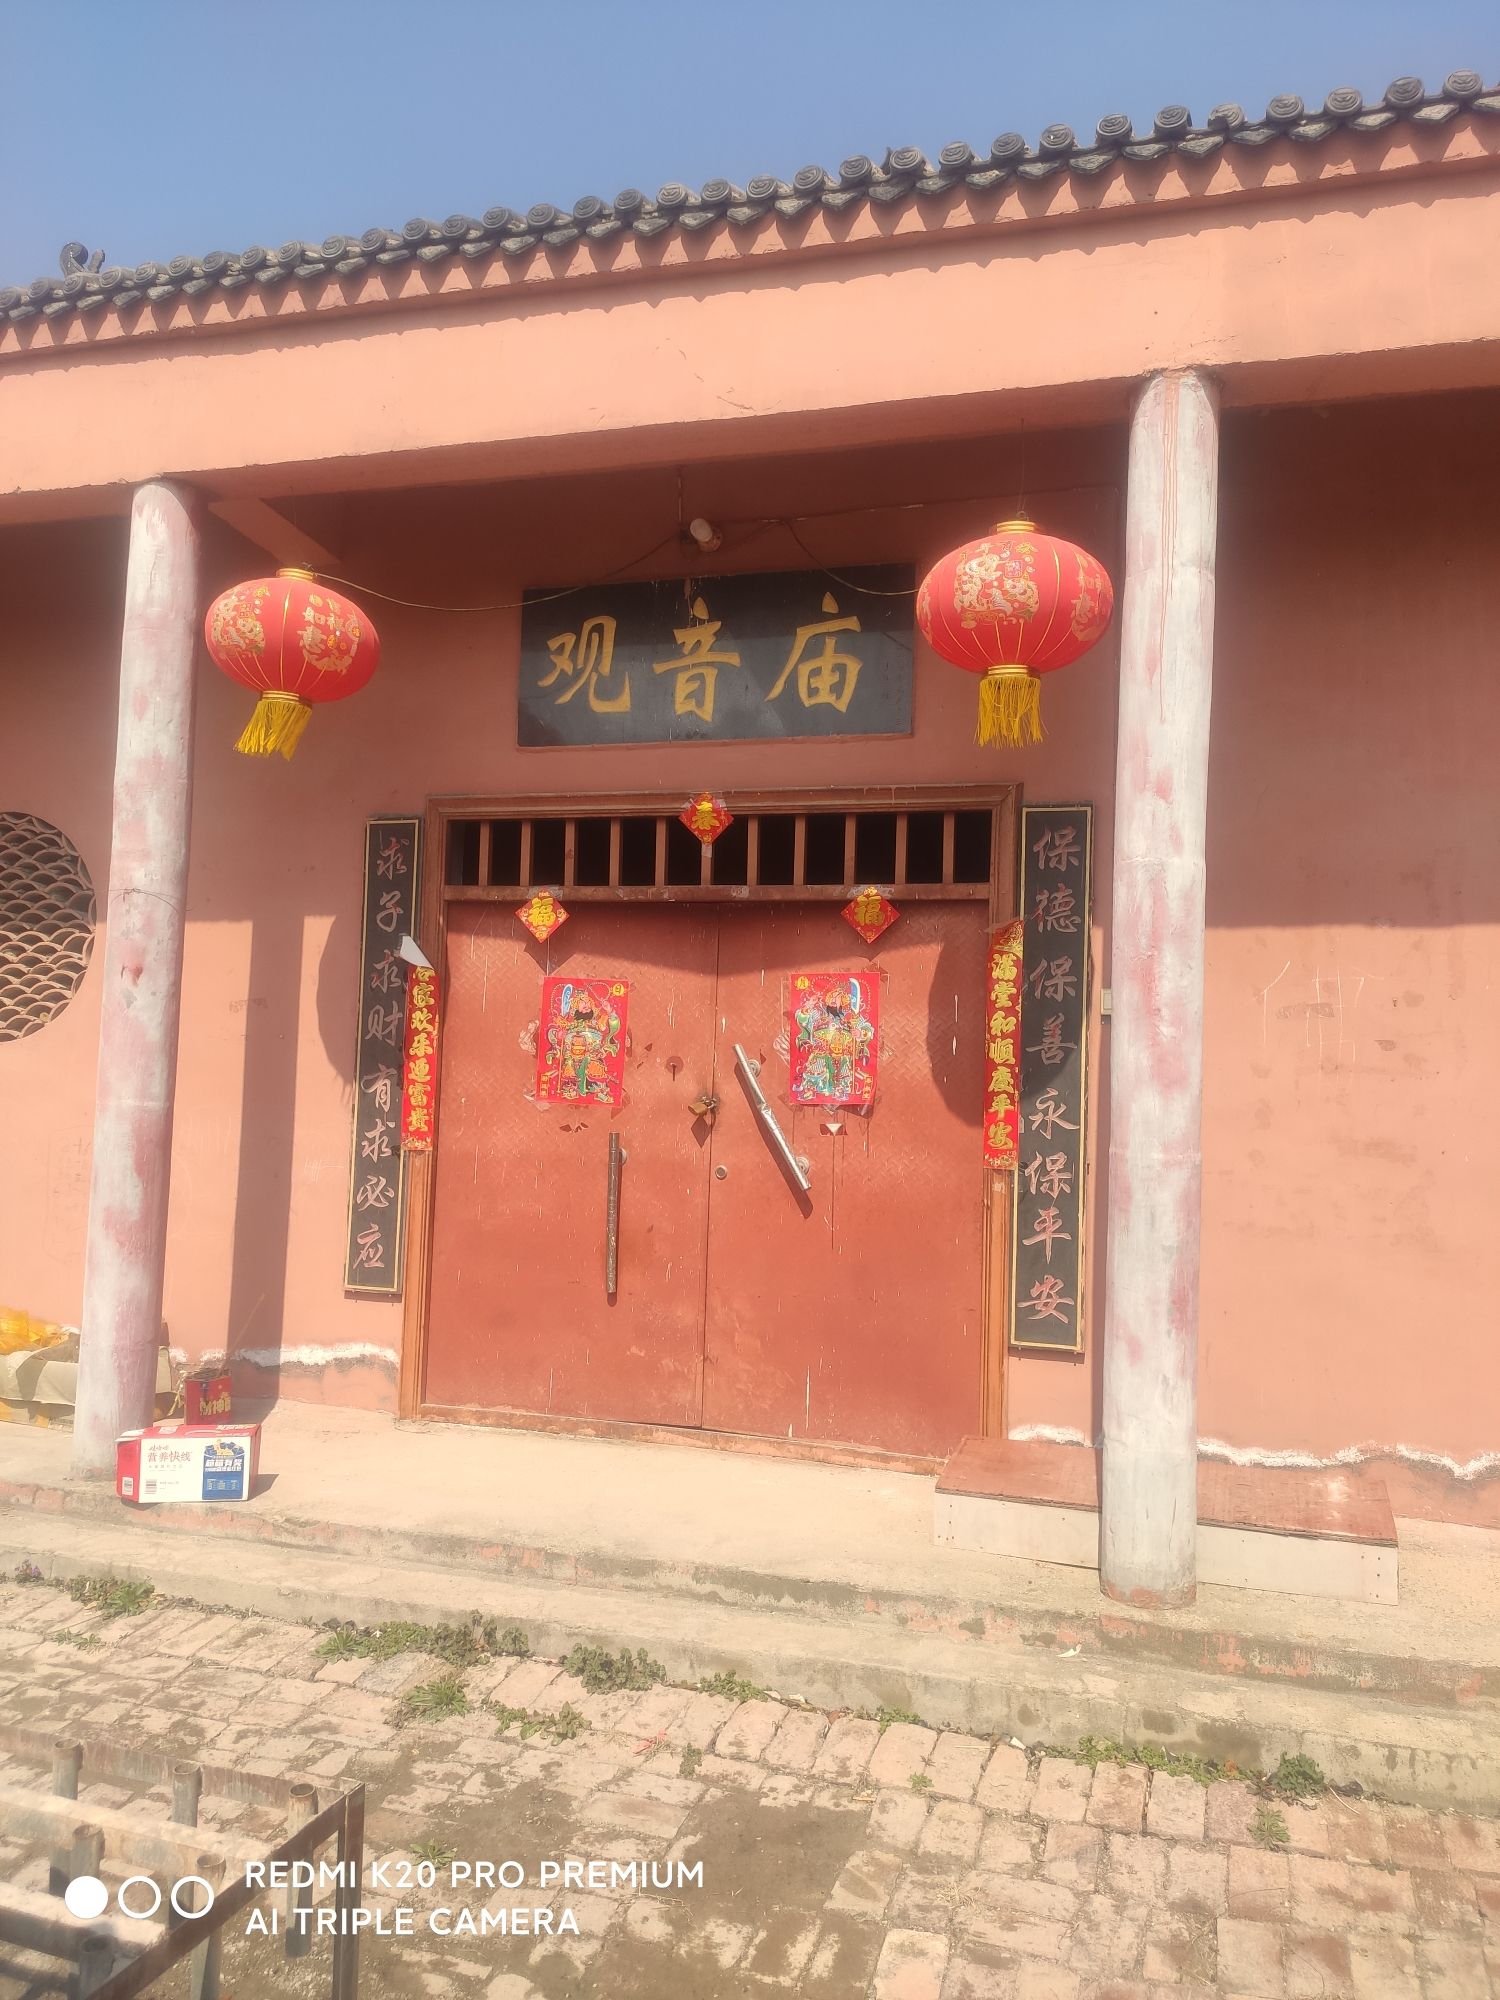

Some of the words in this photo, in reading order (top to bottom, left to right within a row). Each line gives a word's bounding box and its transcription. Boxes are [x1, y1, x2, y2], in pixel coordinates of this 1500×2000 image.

[537, 591, 863, 722] 观音庙
[527, 897, 557, 927] 福
[854, 895, 885, 927] 福
[353, 835, 410, 1270] 求子求财有求必应
[1017, 825, 1081, 1324] 保德保善永保平安
[148, 1451, 191, 1462] 营养快线
